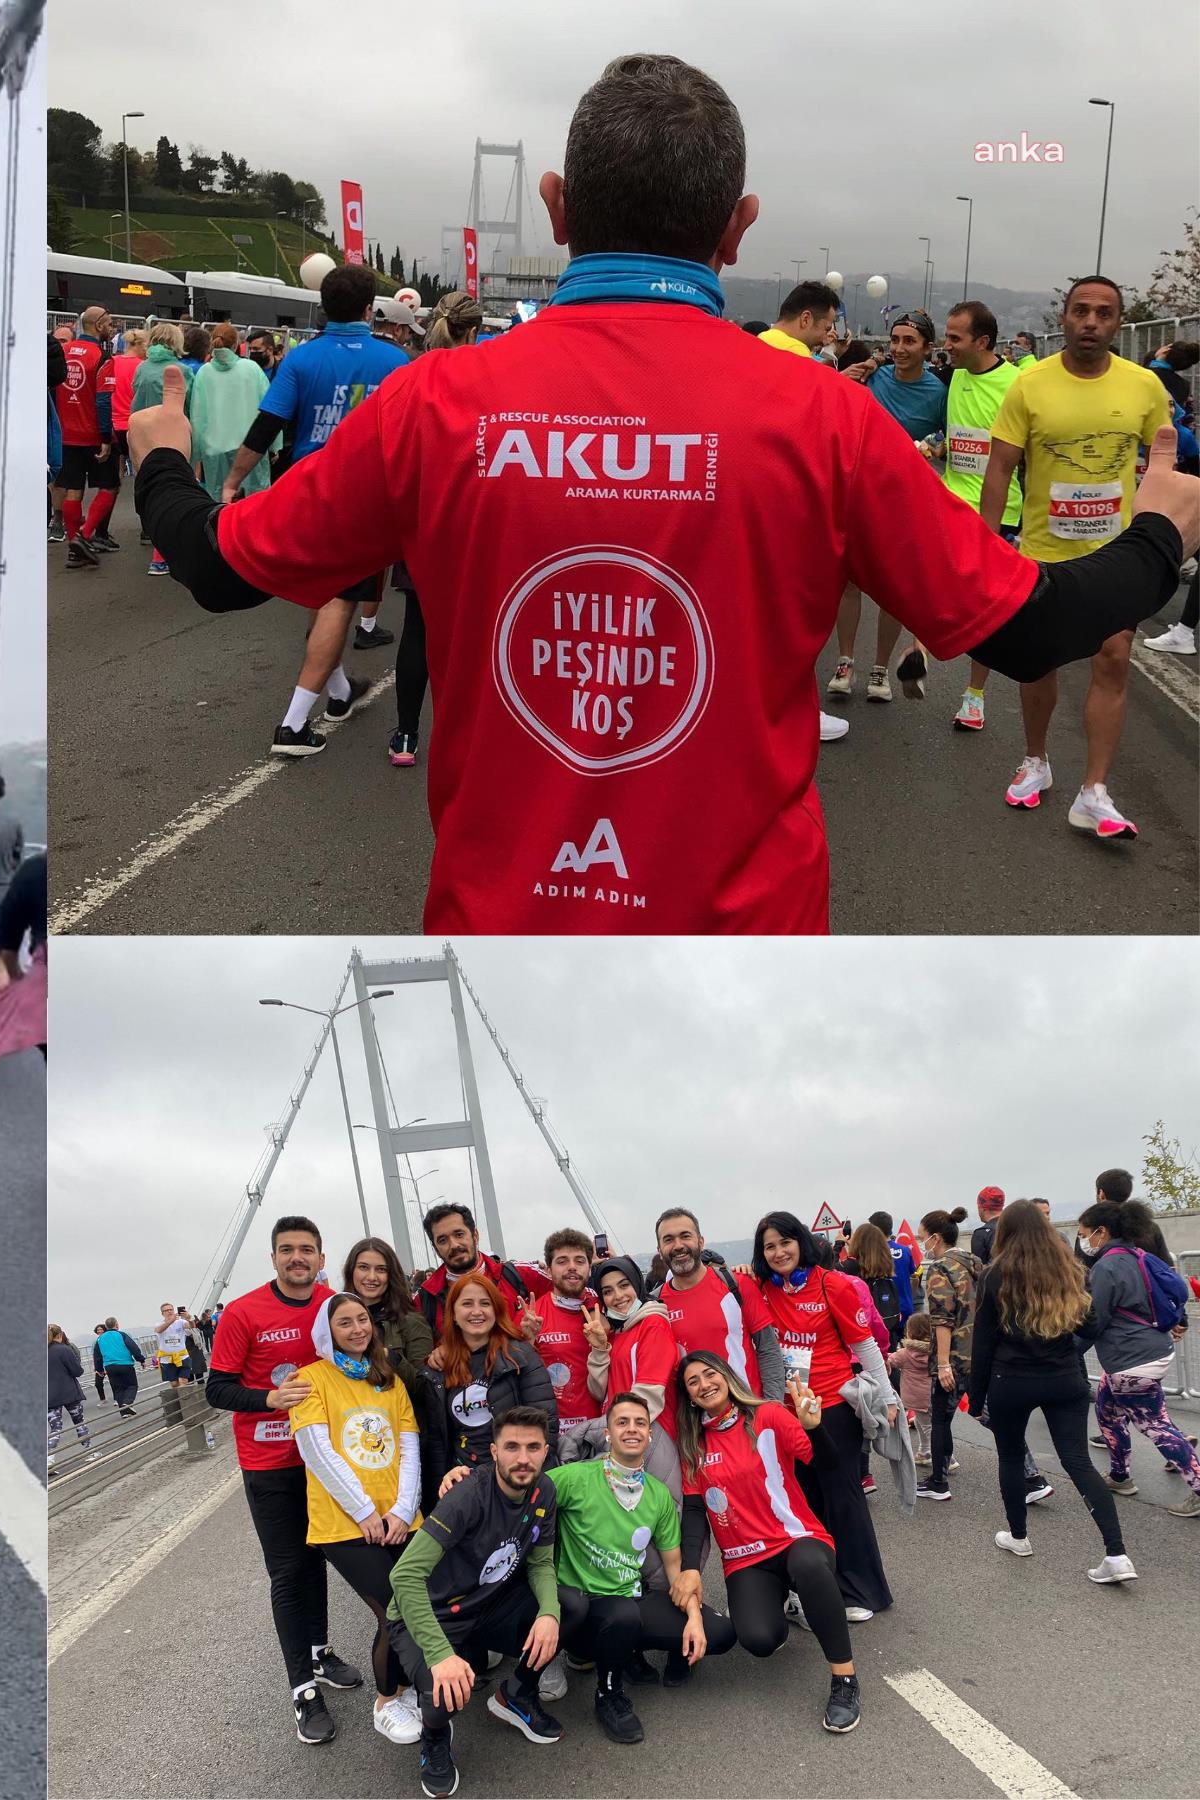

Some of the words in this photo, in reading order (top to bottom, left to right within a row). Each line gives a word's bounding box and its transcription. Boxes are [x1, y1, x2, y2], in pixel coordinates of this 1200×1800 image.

[667, 282, 697, 296] KOLAY
[313, 405, 343, 424] TAN
[476, 415, 487, 478] SEARCH
[490, 414, 497, 423] &
[500, 412, 549, 423] RESCUE
[553, 415, 646, 426] ASSOCIATION
[954, 440, 983, 454] 10256
[486, 429, 702, 482] AKUT
[565, 487, 619, 499] ARAMA
[623, 488, 702, 501] KURTARMA
[704, 433, 719, 501] DERNEĞİ
[1057, 502, 1069, 515] A
[1072, 502, 1115, 515] 10198
[571, 689, 634, 740] KOŞ
[533, 882, 586, 898] ADIM
[594, 887, 646, 908] ADIM
[260, 1328, 297, 1343] AKUT
[538, 1333, 568, 1344] AKUT
[784, 1331, 817, 1344] ADIM
[265, 1422, 285, 1430] HER
[741, 1543, 761, 1554] ADIM
